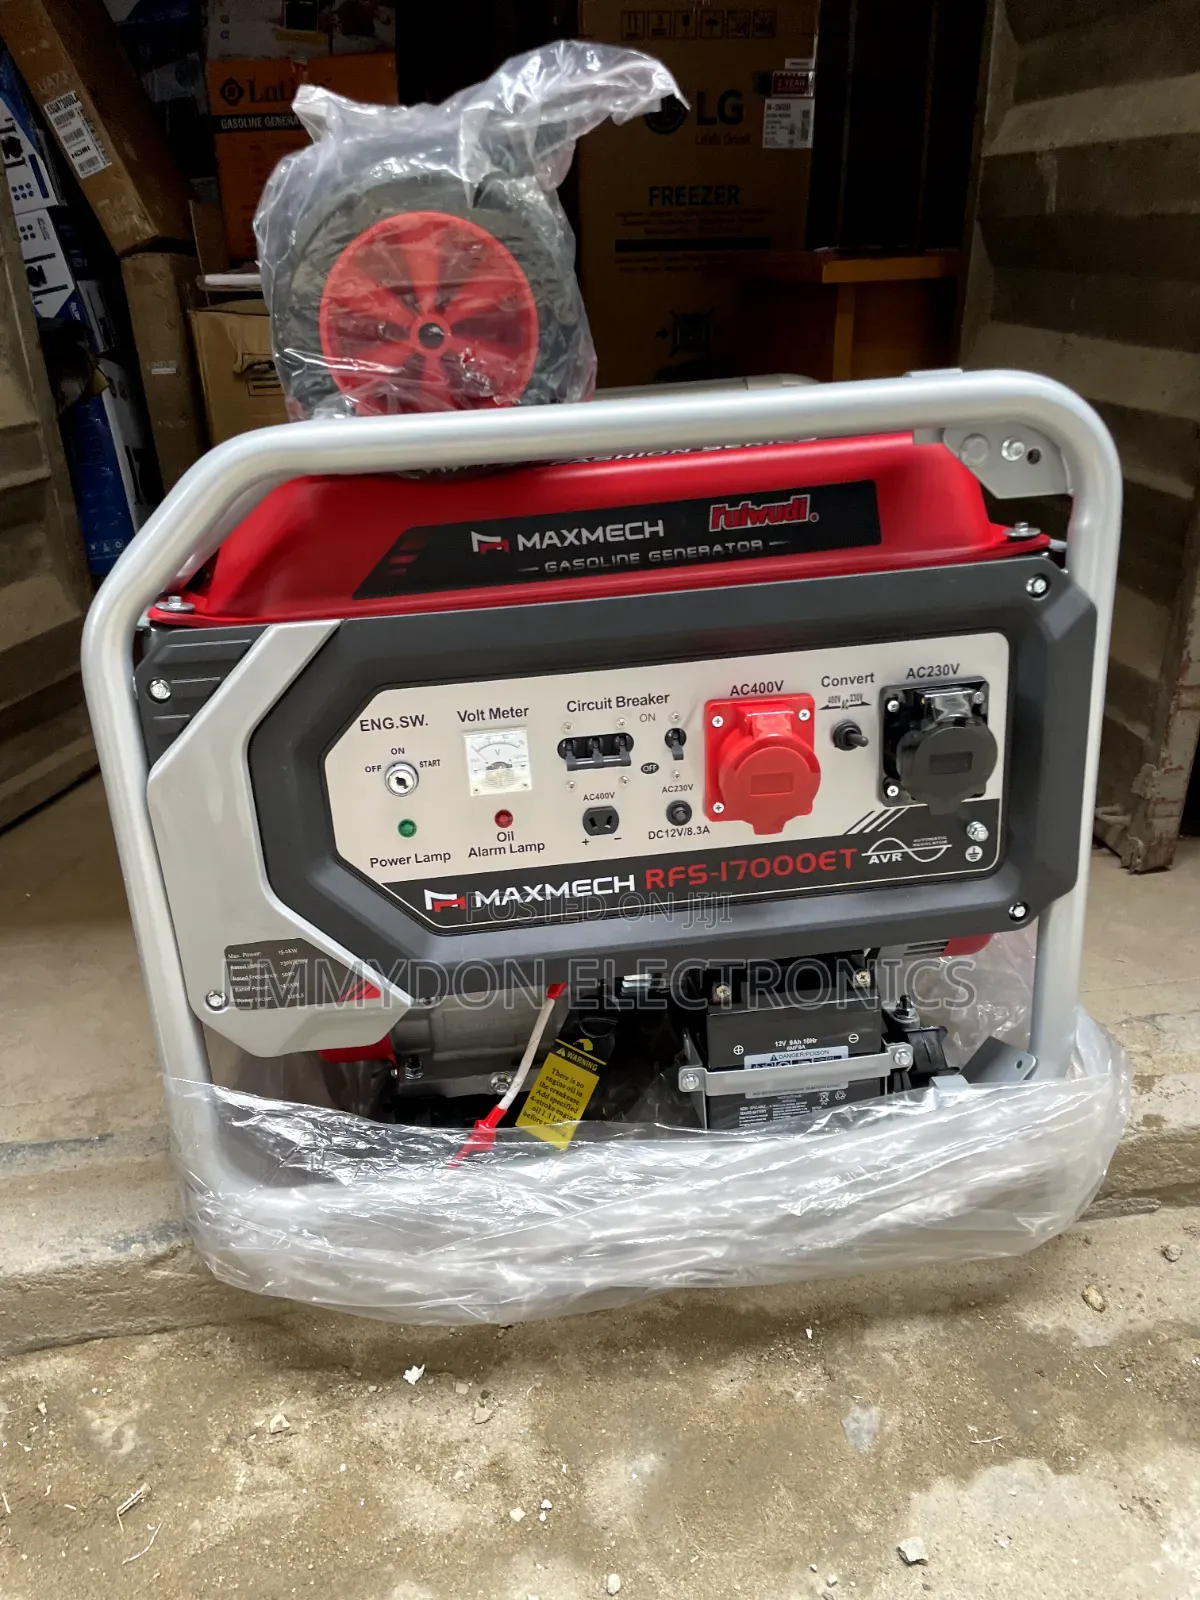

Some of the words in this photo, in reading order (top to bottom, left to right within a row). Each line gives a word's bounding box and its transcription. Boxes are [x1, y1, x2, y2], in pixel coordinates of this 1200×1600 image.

[696, 90, 744, 126] LG
[220, 116, 262, 130] GASOLINE
[264, 114, 301, 127] GENERA
[649, 185, 740, 206] FREEZER
[517, 520, 664, 552] MAXMECH
[544, 552, 640, 574] GASOLINE
[648, 540, 763, 563] GENERATOR
[906, 663, 960, 680] AC230V
[821, 672, 875, 688] Convert
[730, 680, 784, 697] AC400V
[566, 698, 612, 712] Circuit
[616, 694, 670, 708] Breaker
[457, 709, 484, 723] Volt
[488, 706, 529, 720] Meter
[639, 713, 656, 722] ON
[360, 714, 429, 732] ENG.SW.
[390, 747, 405, 755] ON
[365, 765, 382, 773] OFF
[419, 759, 441, 768] START
[643, 764, 657, 773] OFF
[583, 792, 615, 801] AC400V
[662, 784, 694, 794] AC230V
[496, 831, 514, 842] Oil
[648, 826, 710, 840] DC12V/8.3A
[468, 846, 506, 858] Alarm
[509, 841, 546, 854] Lamp
[370, 854, 411, 868] Power
[414, 852, 452, 865] Lamp
[868, 852, 903, 864] AVR
[475, 874, 635, 908] MAXMECH
[646, 848, 858, 890] RFS-17000ET
[566, 1050, 598, 1071] WARNING
[778, 1050, 829, 1059] DANGER/POISON
[539, 1082, 549, 1090] the
[546, 1075, 566, 1089] engine
[566, 1084, 576, 1094] oil
[536, 1089, 548, 1100] Add
[550, 1096, 579, 1114] specified
[523, 1111, 543, 1125] before
[532, 1106, 541, 1114] oil
